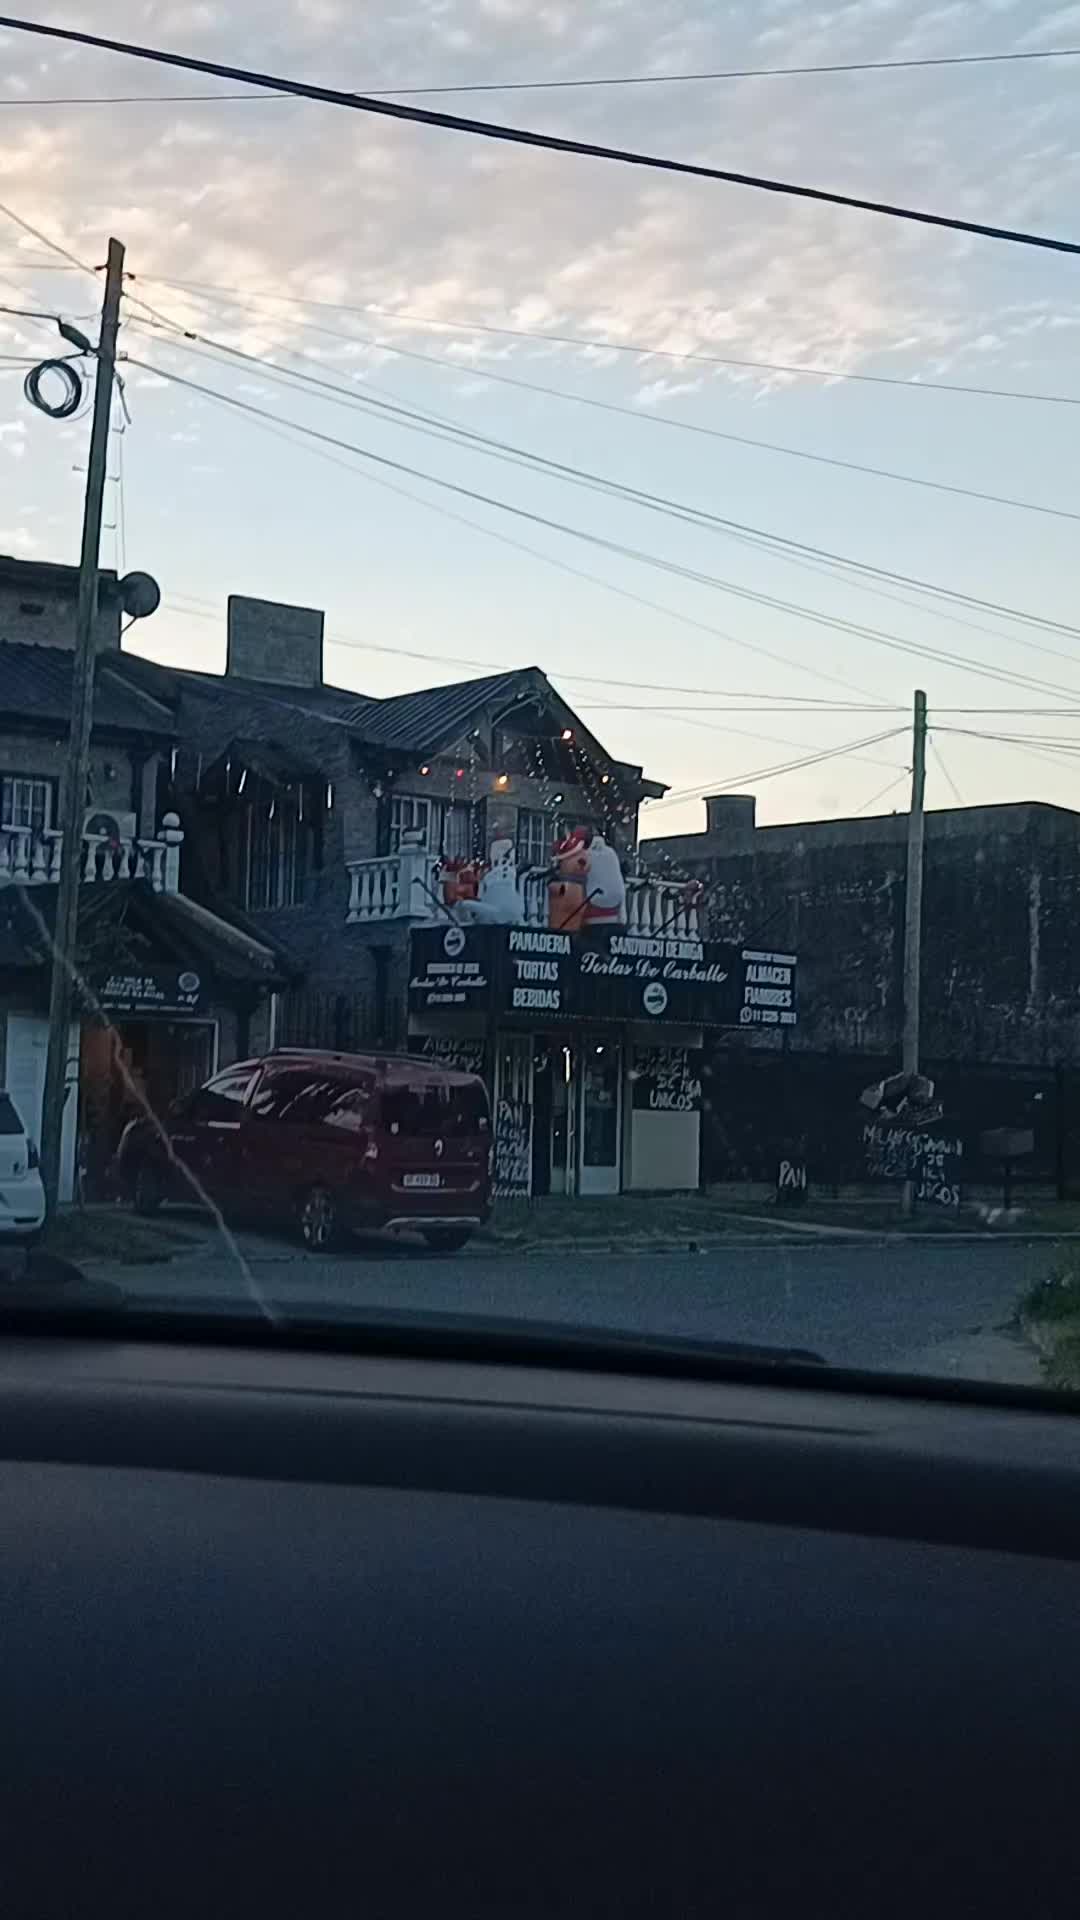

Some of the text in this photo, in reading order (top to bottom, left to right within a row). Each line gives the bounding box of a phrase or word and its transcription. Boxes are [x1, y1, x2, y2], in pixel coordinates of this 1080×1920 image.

[509, 930, 571, 955] PANADERIA
[516, 959, 559, 981] TORTAS
[513, 987, 561, 1009] BEBIDAS
[779, 1160, 807, 1189] PAN
